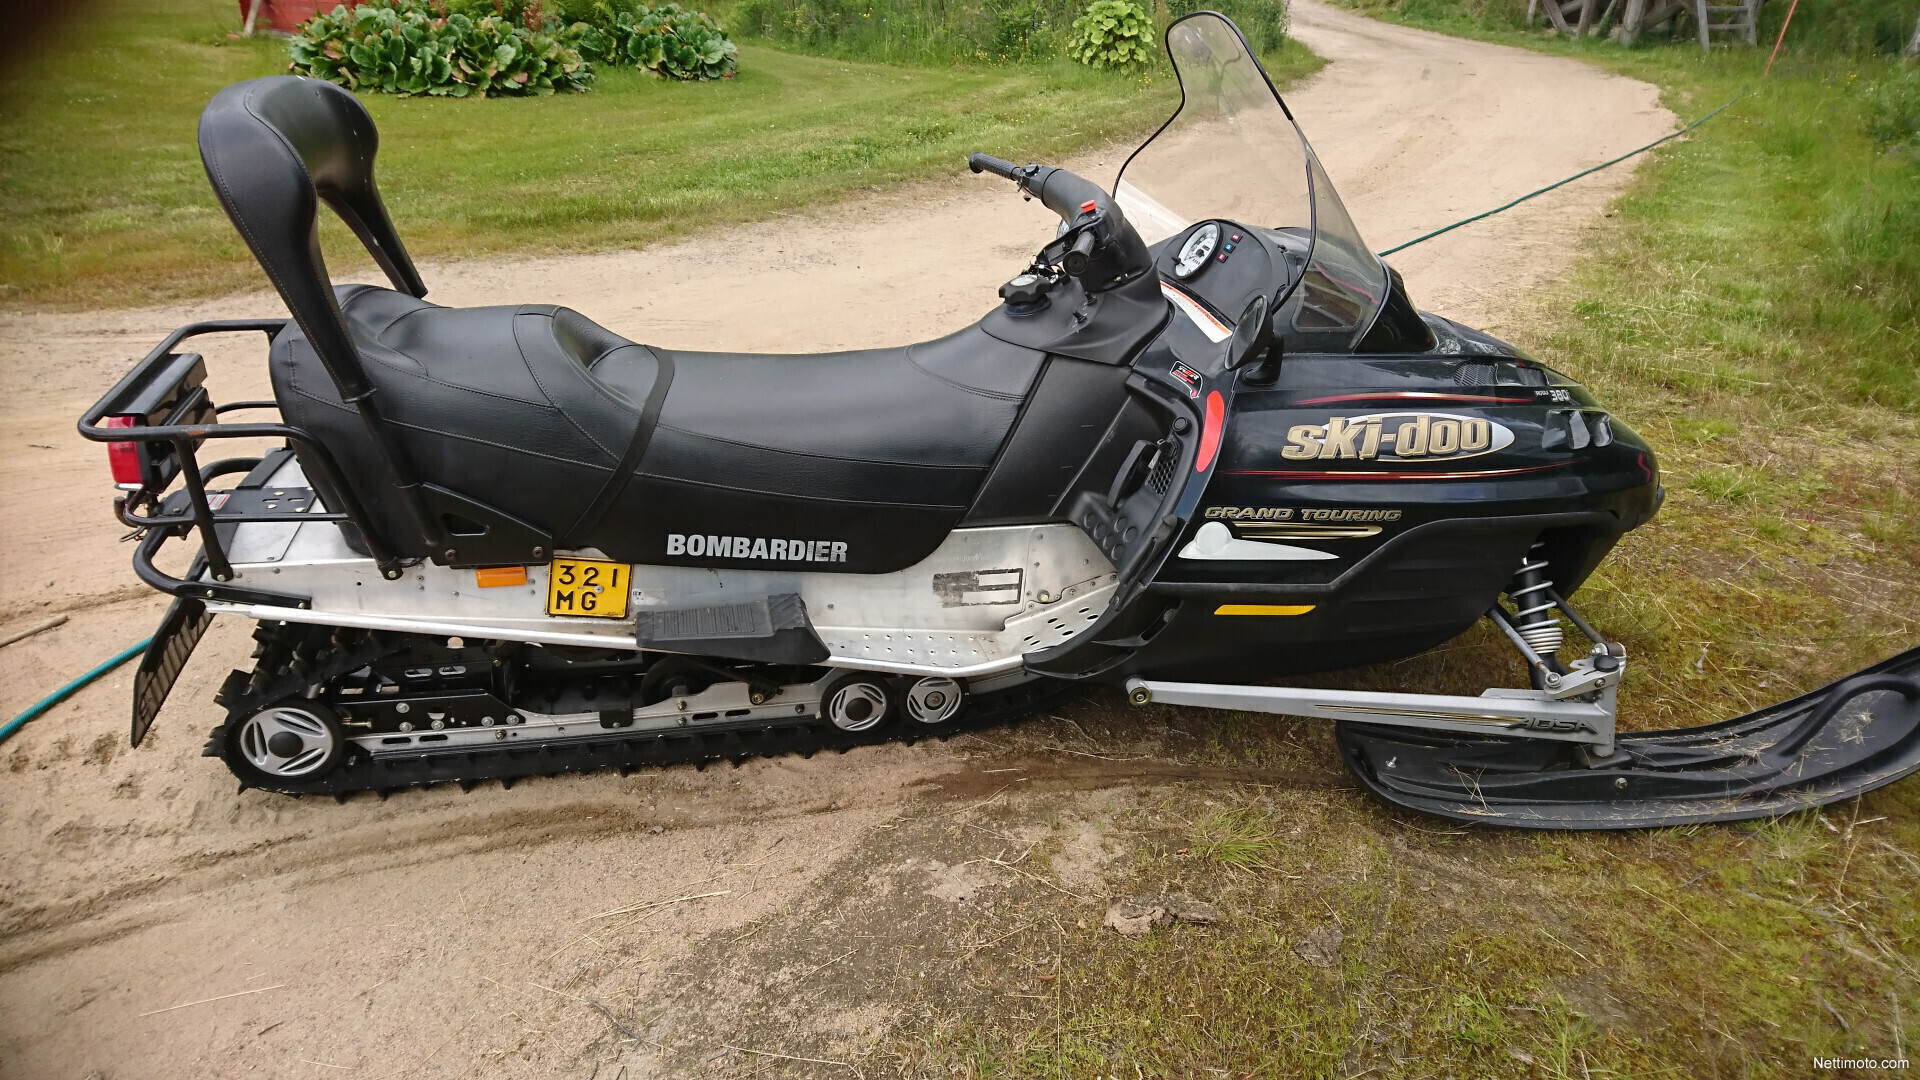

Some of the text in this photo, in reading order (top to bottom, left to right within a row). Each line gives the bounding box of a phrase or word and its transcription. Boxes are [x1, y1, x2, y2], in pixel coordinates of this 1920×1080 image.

[1280, 415, 1493, 461] ski-doo
[1204, 506, 1402, 523] GRAND TOURING
[666, 534, 849, 563] BOMBARDIER
[555, 589, 598, 611] MG
